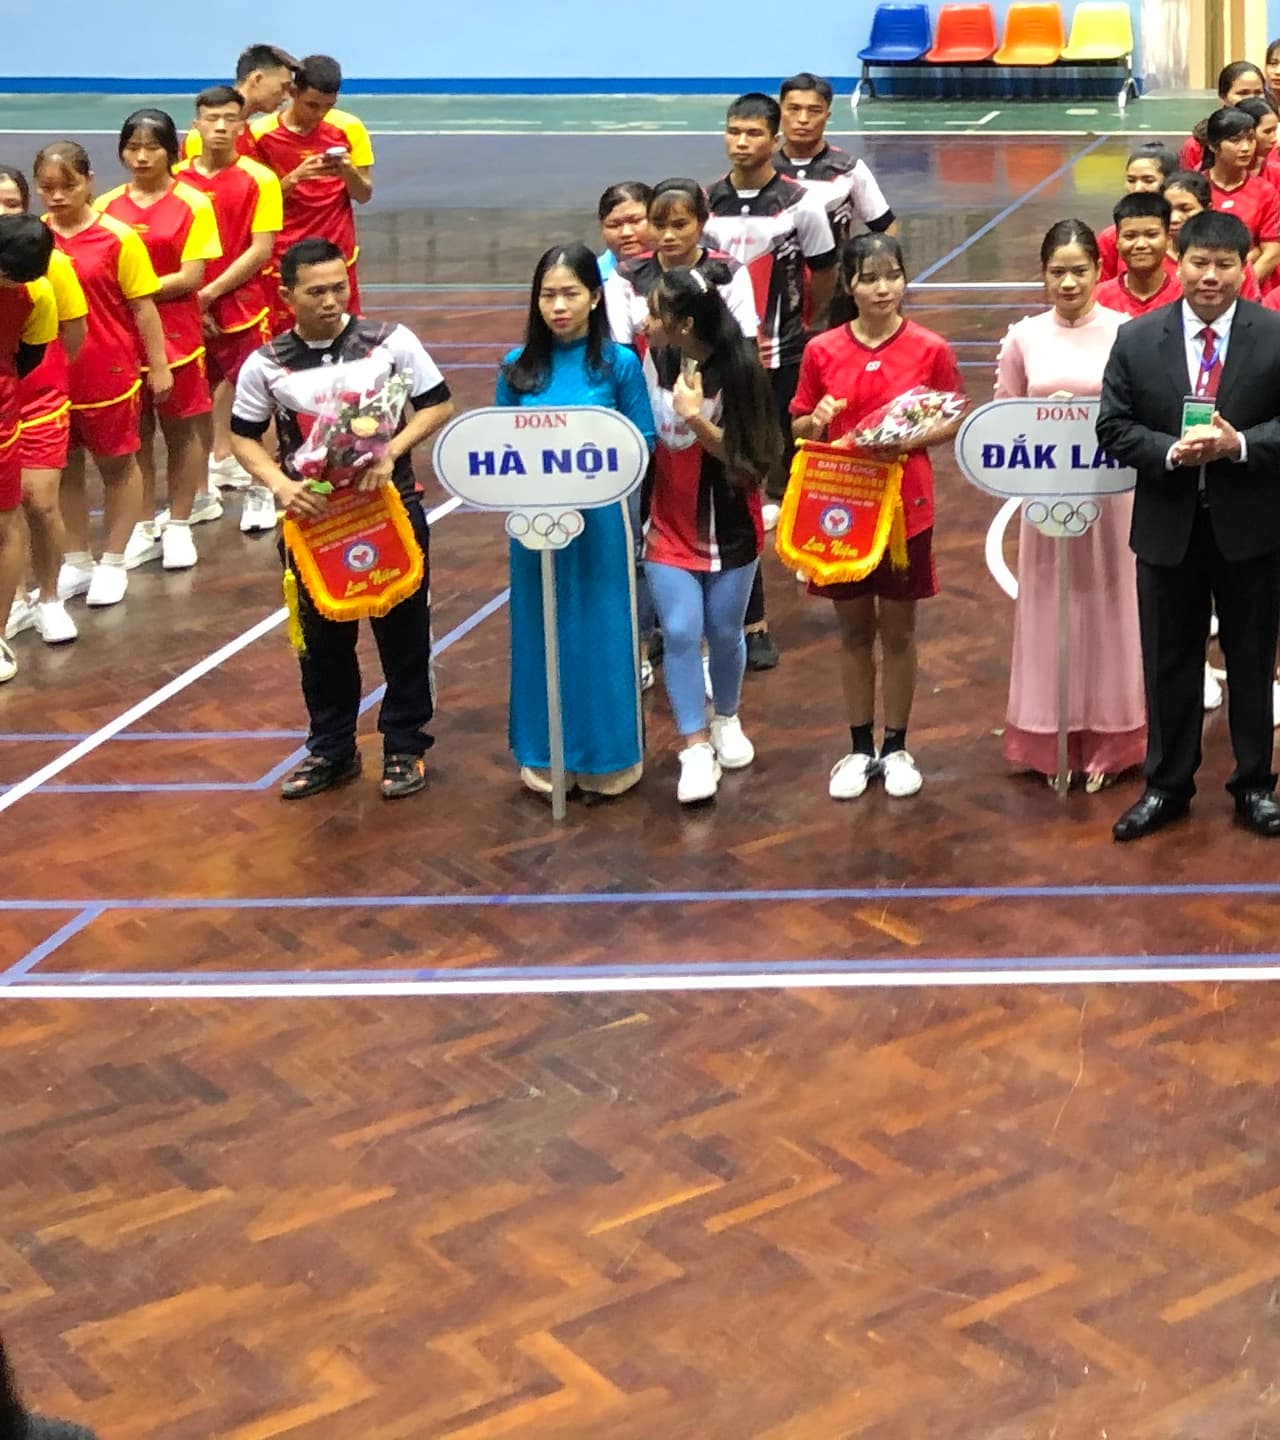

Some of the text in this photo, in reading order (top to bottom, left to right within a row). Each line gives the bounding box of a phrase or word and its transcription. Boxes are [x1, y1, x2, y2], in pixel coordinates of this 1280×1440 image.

[468, 442, 618, 479] HÀ NỘI
[982, 434, 1056, 469] ĐẮK
